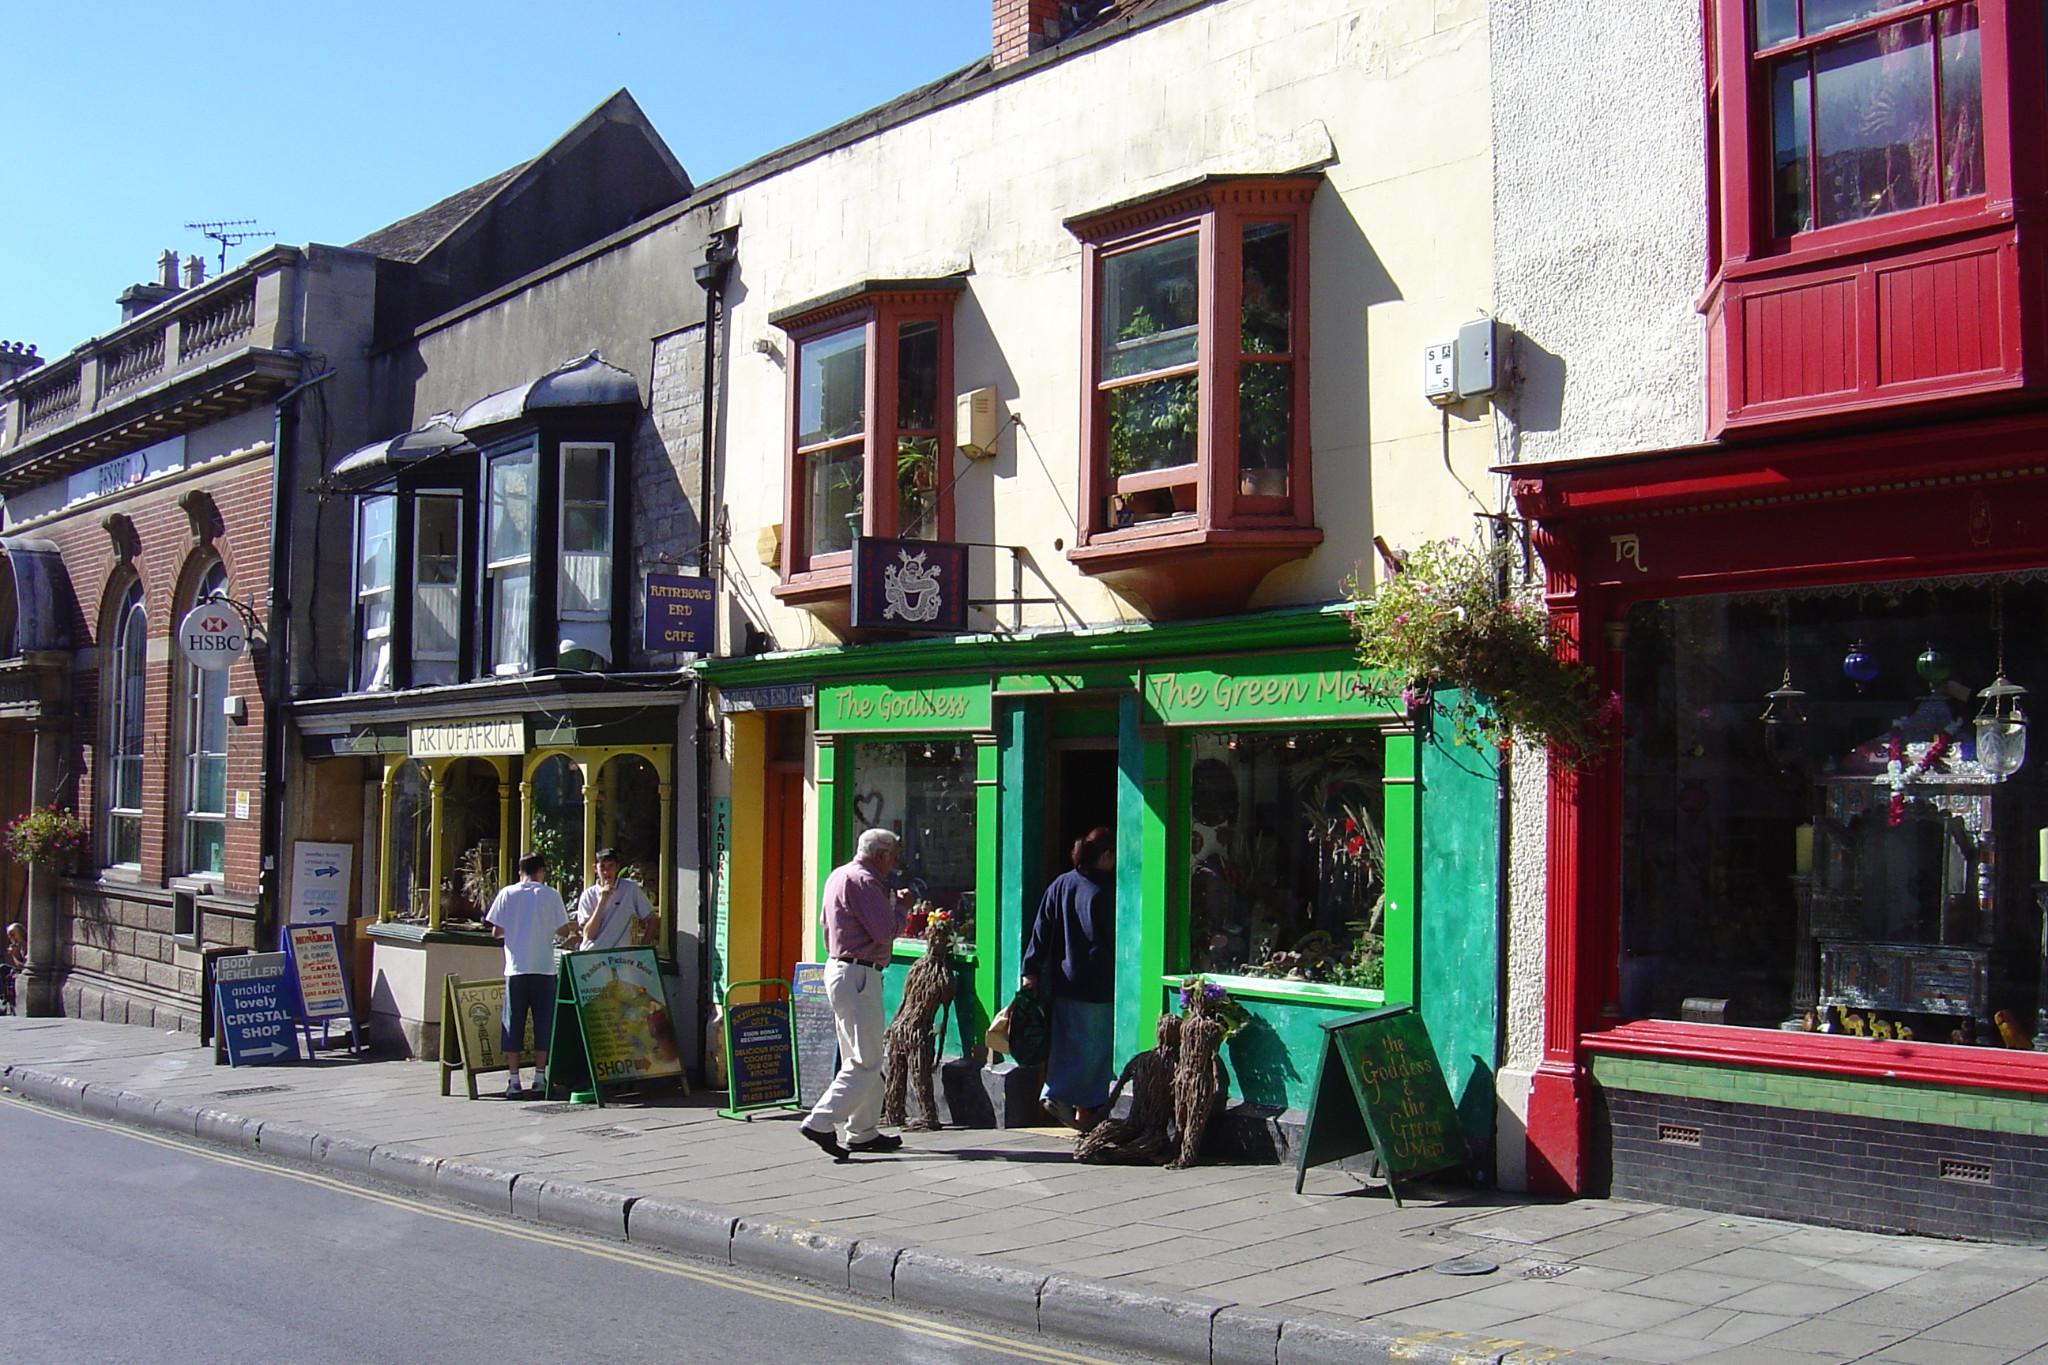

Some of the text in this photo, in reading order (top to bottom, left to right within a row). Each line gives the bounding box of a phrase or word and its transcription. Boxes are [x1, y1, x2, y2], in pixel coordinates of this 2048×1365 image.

[99, 457, 130, 496] HSBC
[189, 634, 240, 651] HSBC
[664, 630, 695, 642] CAFE
[1149, 673, 1208, 710] The
[1214, 674, 1310, 711] Green
[835, 686, 970, 722] The Goddess
[419, 719, 516, 751] ART OF AFRICA
[717, 813, 726, 881] PANDORA
[295, 933, 332, 945] MONARCH
[311, 943, 334, 951] ROOMS
[222, 958, 253, 970] BODY
[311, 964, 338, 972] CAKES
[218, 966, 286, 982] JEWELLERY
[301, 974, 322, 982] CREAM
[232, 983, 276, 997] another
[305, 988, 344, 998] BREAKFAST
[461, 986, 506, 1003] ART OF
[235, 996, 276, 1009] lovely
[227, 1010, 292, 1026] CRYSTAL
[242, 1025, 281, 1039] SHOP
[740, 1034, 782, 1043] RECOMMENDED
[734, 1044, 790, 1057] DELICIOUS FOOD
[1382, 1034, 1405, 1055] the
[743, 1054, 773, 1064] COOKED
[763, 1061, 780, 1069] OWN
[596, 1060, 634, 1077] SHOP
[751, 1068, 778, 1077] KITCHEN
[1362, 1053, 1432, 1105] Goddess
[1401, 1097, 1425, 1118] the
[1390, 1112, 1442, 1158] Green
[1409, 1139, 1446, 1170] Man
